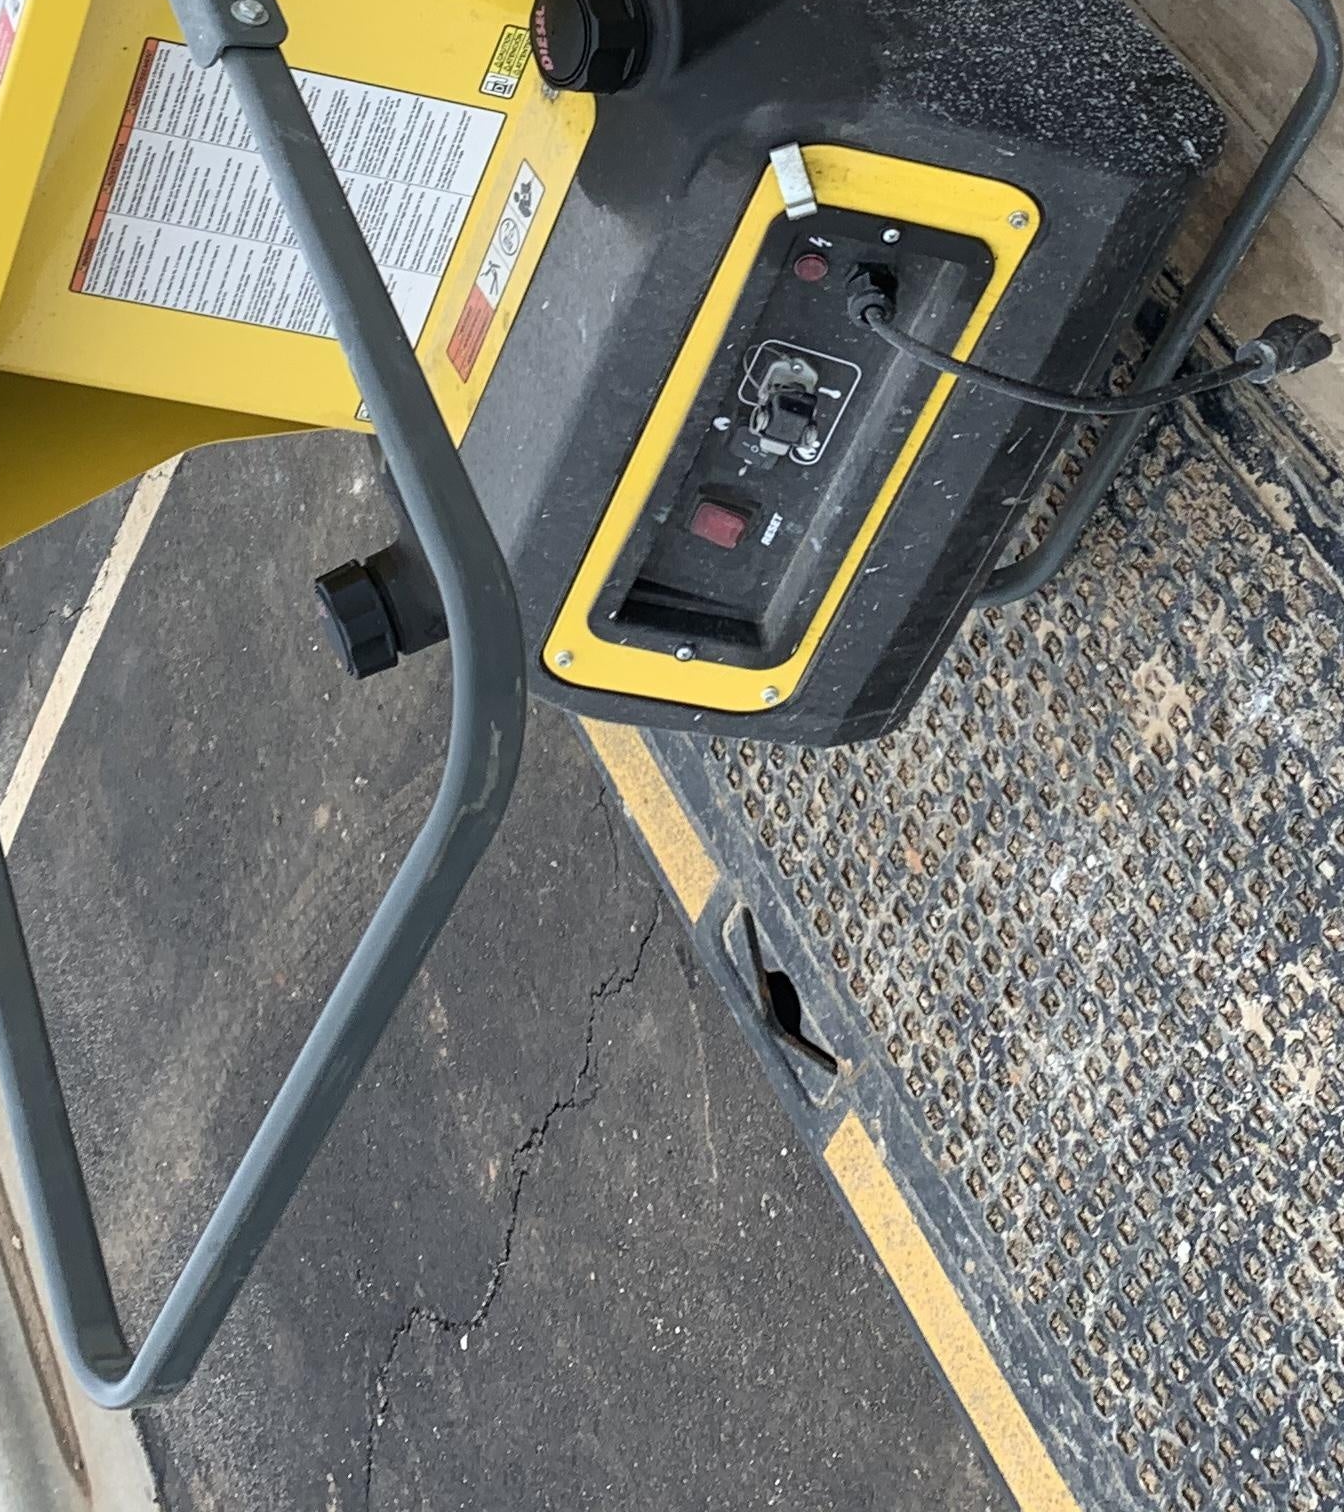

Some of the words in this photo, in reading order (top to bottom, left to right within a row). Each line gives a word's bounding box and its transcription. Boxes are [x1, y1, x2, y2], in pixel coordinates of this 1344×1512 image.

[497, 32, 513, 62] CAUTION
[536, 5, 554, 71] DIESEL
[760, 511, 783, 546] RESET
